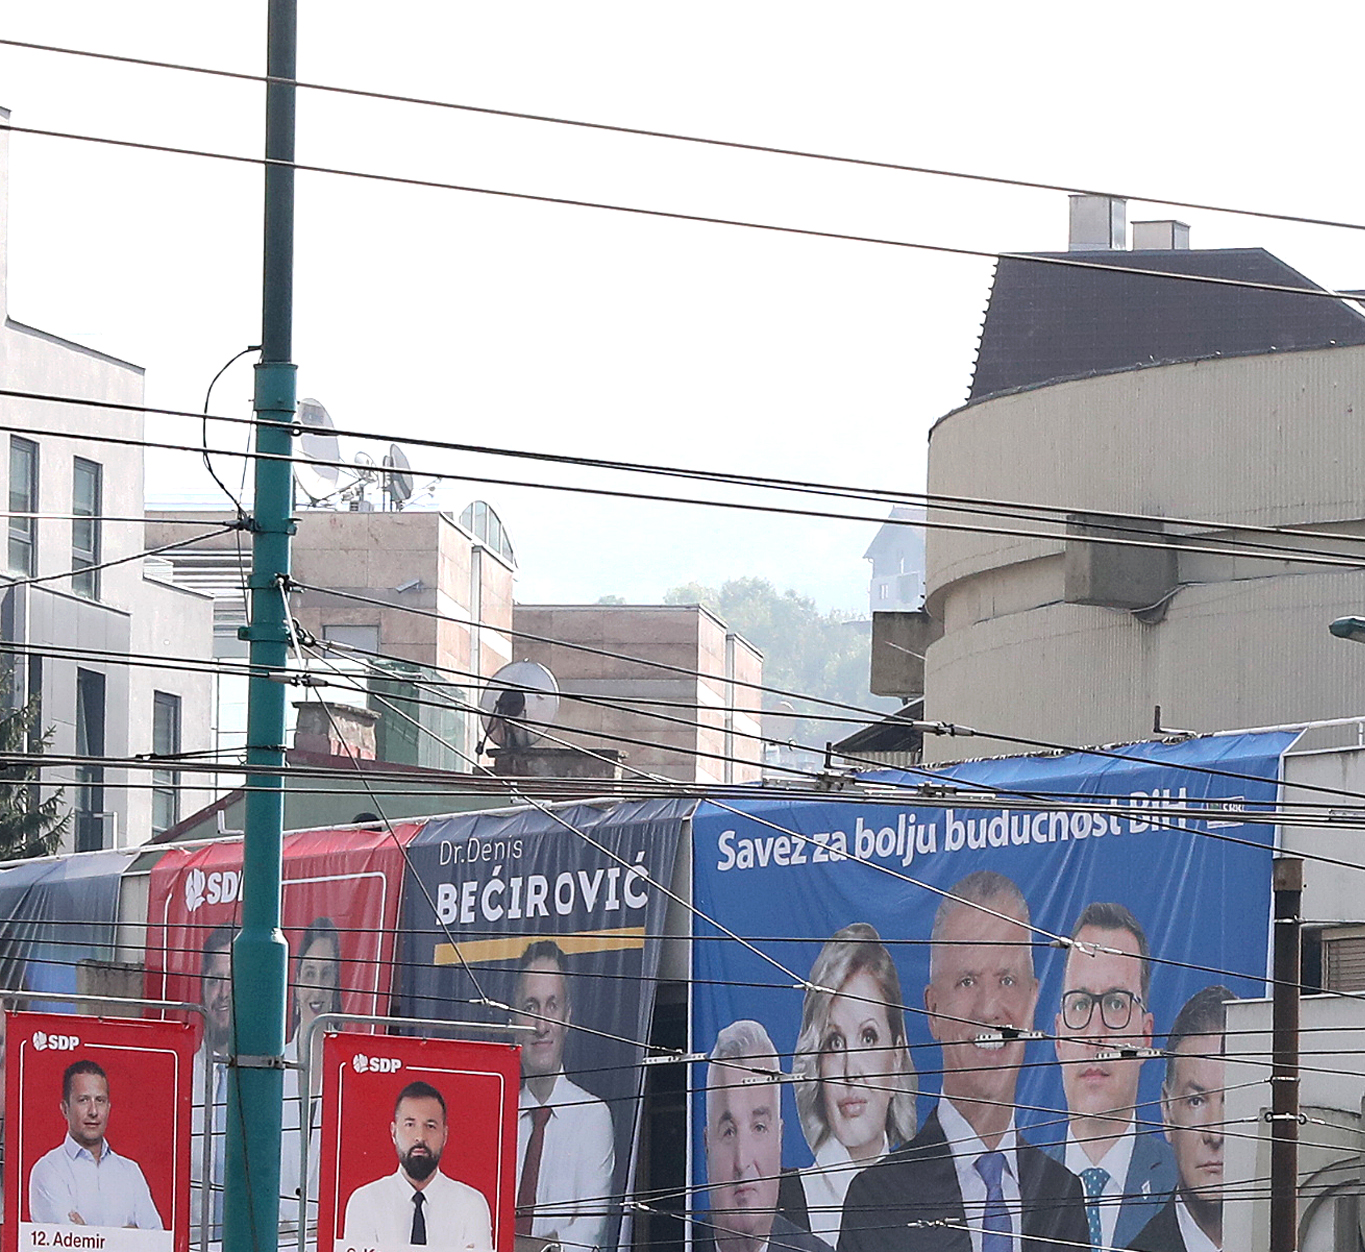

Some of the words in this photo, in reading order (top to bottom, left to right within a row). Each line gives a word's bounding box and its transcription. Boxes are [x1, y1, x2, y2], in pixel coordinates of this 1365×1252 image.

[716, 829, 806, 872] Savez
[812, 832, 847, 863] za
[855, 812, 937, 866] bolju
[436, 851, 649, 926] BEĆIROVIĆ
[48, 1034, 80, 1051] SDP
[370, 1057, 402, 1074] SDP
[31, 1231, 49, 1246] 12.
[53, 1232, 105, 1249] Ademir
